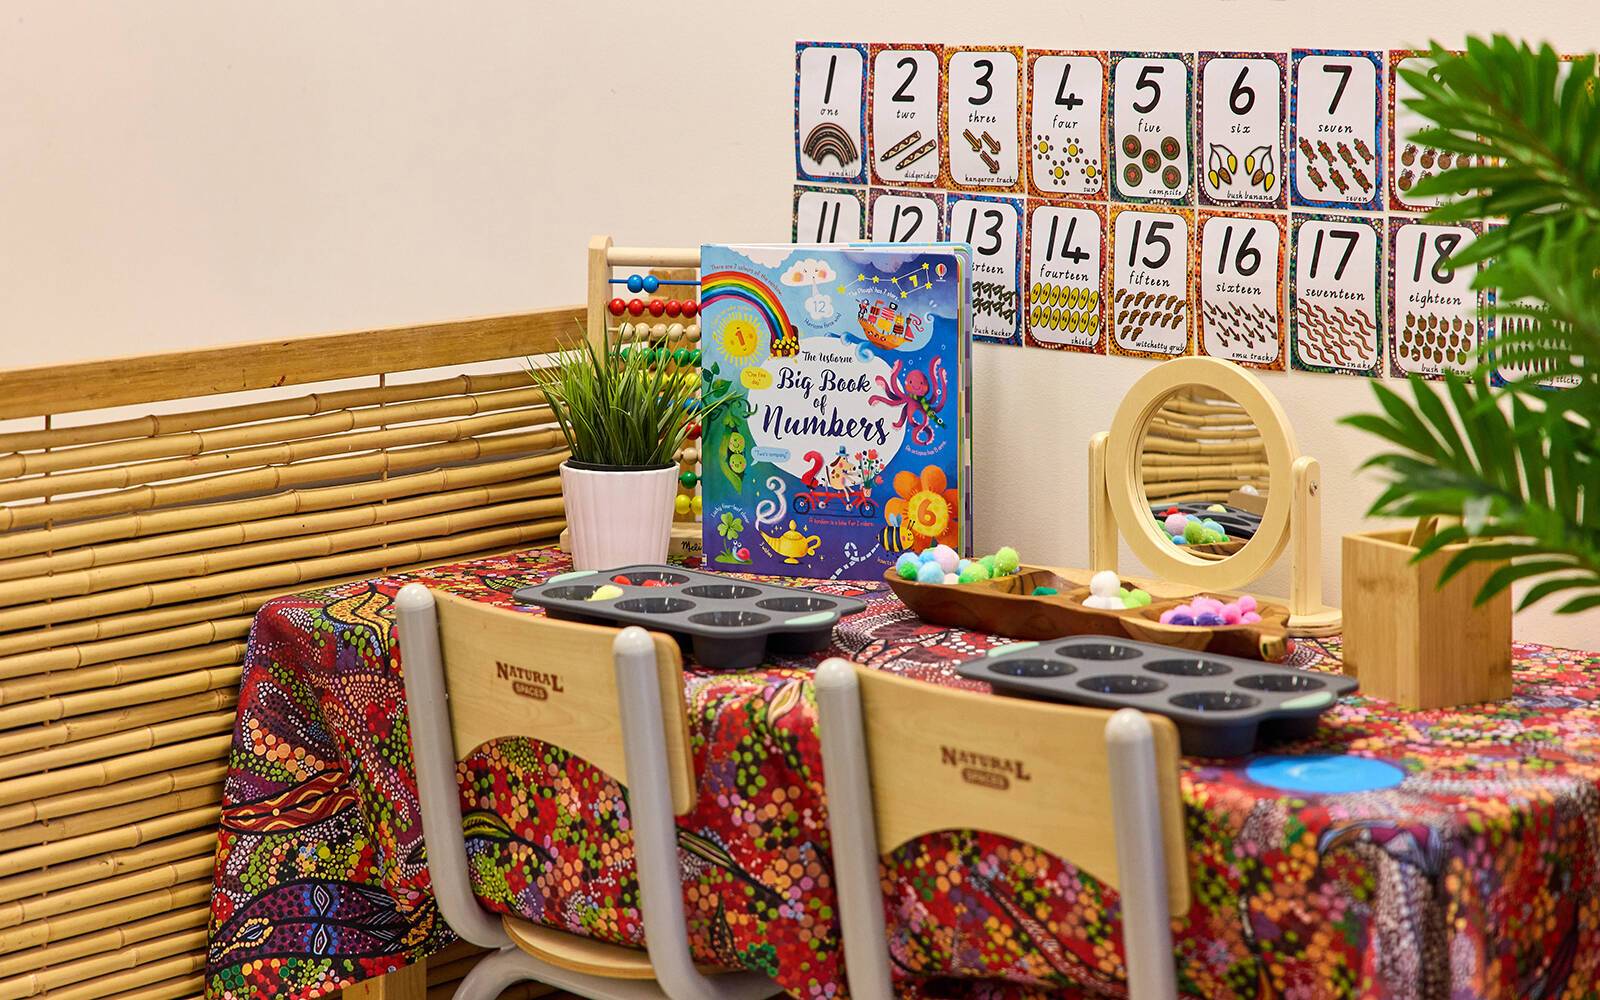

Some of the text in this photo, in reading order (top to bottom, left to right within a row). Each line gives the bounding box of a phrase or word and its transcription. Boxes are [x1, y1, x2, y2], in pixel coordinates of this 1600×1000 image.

[823, 54, 837, 105] 1
[891, 57, 919, 103] 2
[968, 59, 994, 106] 3
[1054, 63, 1084, 111] 4
[1132, 65, 1165, 114] 5
[1229, 66, 1255, 116] 6
[1322, 64, 1353, 115] 7
[820, 106, 839, 117] one
[896, 109, 917, 120] two
[968, 112, 997, 124] three
[1052, 114, 1079, 130] four
[1138, 118, 1162, 133] five
[1230, 121, 1251, 134] six
[1318, 124, 1353, 134] seven
[965, 173, 1016, 185] kangaroo tracks
[1149, 187, 1182, 197] campsite
[1227, 190, 1273, 201] bush banana
[816, 201, 841, 243] 11
[889, 204, 924, 243] 12
[966, 208, 1003, 255] 13
[1046, 215, 1090, 264] 14
[1128, 220, 1174, 269] 15
[1218, 226, 1262, 277] 16
[1309, 229, 1360, 281] 17
[1413, 232, 1462, 284] 18
[972, 262, 1004, 274] irteen
[1039, 264, 1089, 282] fourteen
[909, 275, 918, 287] 7
[1129, 271, 1171, 288] fifteen
[1216, 282, 1262, 296] sixteen
[1305, 287, 1366, 301] seventeen
[814, 301, 826, 313] 12
[1408, 290, 1463, 308] eighteen
[1509, 300, 1549, 311] ninet
[974, 325, 989, 335] bush
[736, 331, 745, 346] 1
[1071, 336, 1093, 346] shield
[1135, 340, 1185, 355] witchetty grub
[802, 351, 853, 363] The Usborne
[1231, 353, 1274, 362] emu tracks
[1346, 360, 1371, 369] snake
[1421, 363, 1439, 373] bush
[776, 366, 872, 398] Big Book
[813, 395, 828, 415] of
[762, 404, 890, 446] Numbers
[801, 450, 823, 488] 2
[755, 476, 787, 528] 3
[917, 499, 937, 527] 6
[681, 540, 702, 552] Meli
[496, 660, 564, 692] NATURAL
[515, 682, 545, 697] SPACES
[941, 745, 1031, 781] NATURAL
